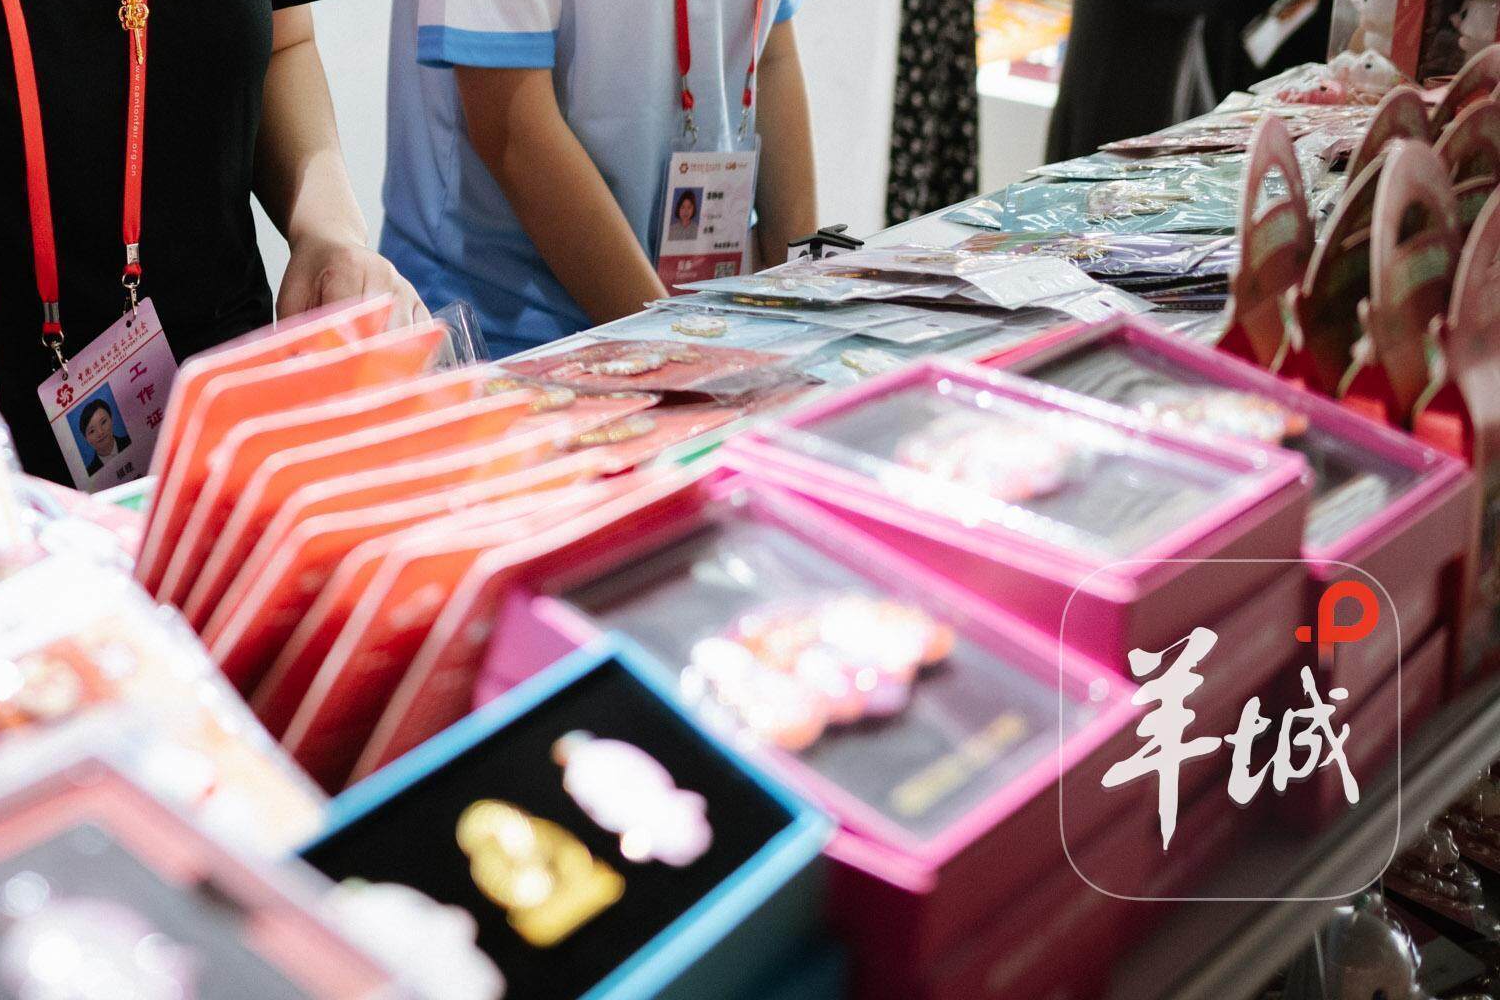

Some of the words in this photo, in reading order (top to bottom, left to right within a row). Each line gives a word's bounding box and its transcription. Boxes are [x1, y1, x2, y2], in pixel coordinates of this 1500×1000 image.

[130, 63, 142, 177] ww.cantonfair.org.cn
[129, 361, 164, 430] 工作证
